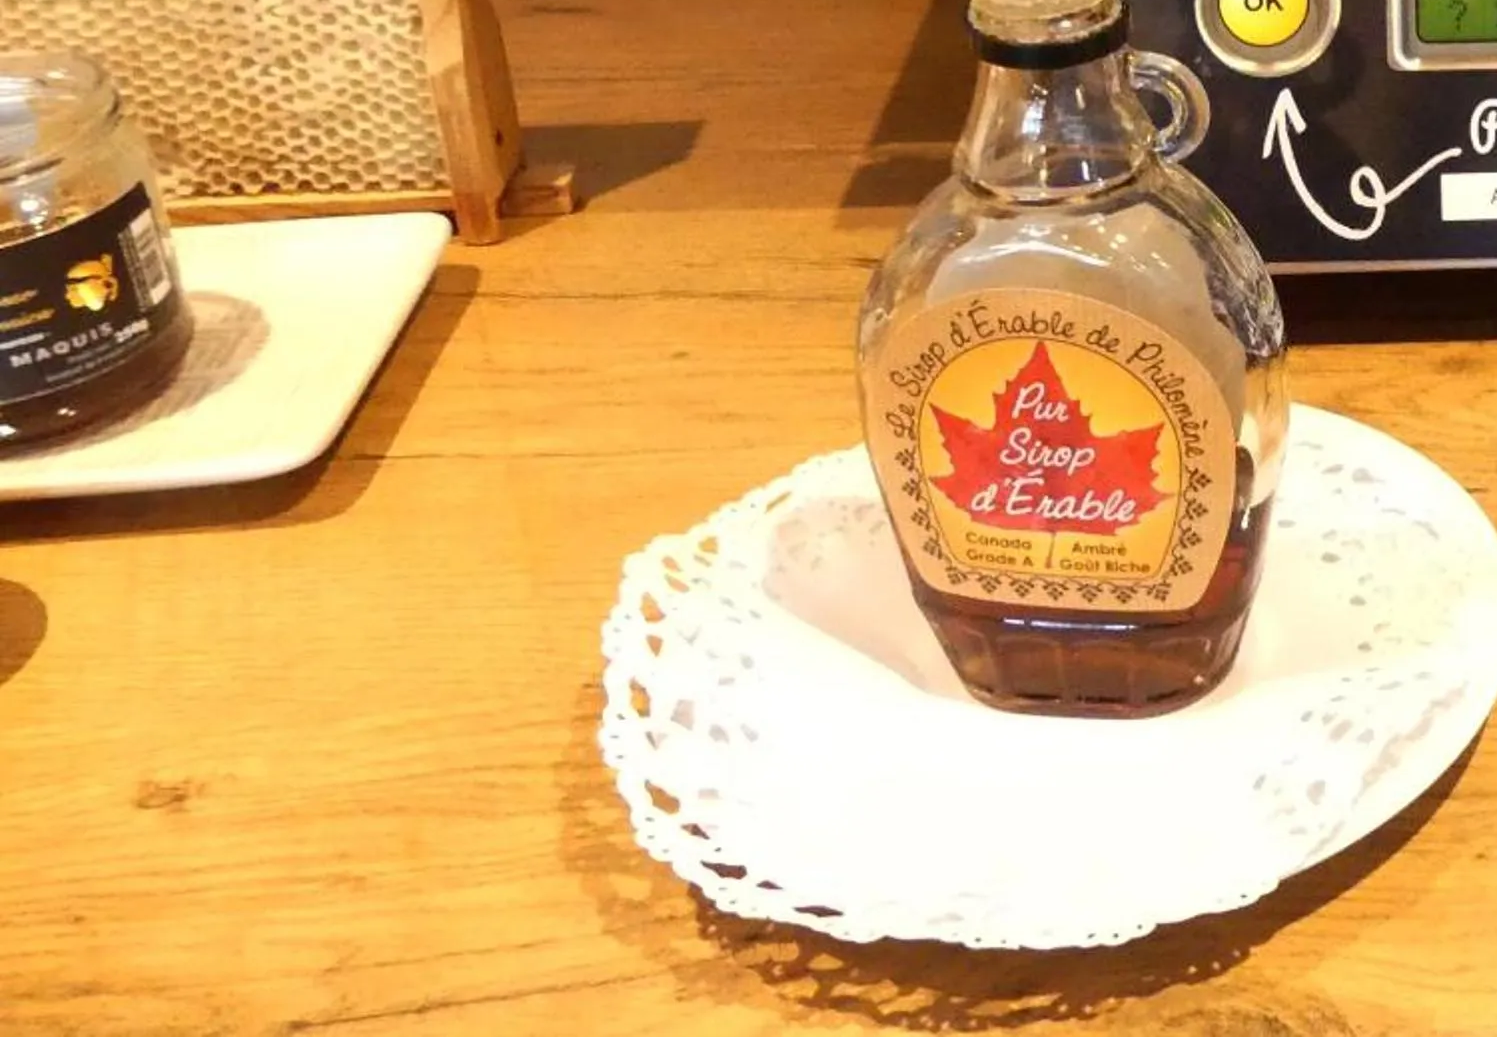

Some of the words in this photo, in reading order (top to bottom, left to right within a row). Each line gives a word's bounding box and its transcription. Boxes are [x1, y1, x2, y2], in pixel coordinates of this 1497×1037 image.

[1448, 0, 1468, 31] ?
[9, 321, 114, 368] MAQUIS
[890, 342, 948, 396] Sirop
[1085, 324, 1121, 353] de
[1011, 382, 1070, 423] Pur
[1000, 427, 1097, 475] Sirop
[970, 470, 1138, 524] d'Érable
[965, 532, 1033, 551] Canada
[966, 549, 1017, 566] Grade
[1022, 555, 1034, 568] A
[1071, 541, 1128, 557] Ambré
[1105, 561, 1152, 574] Riche
